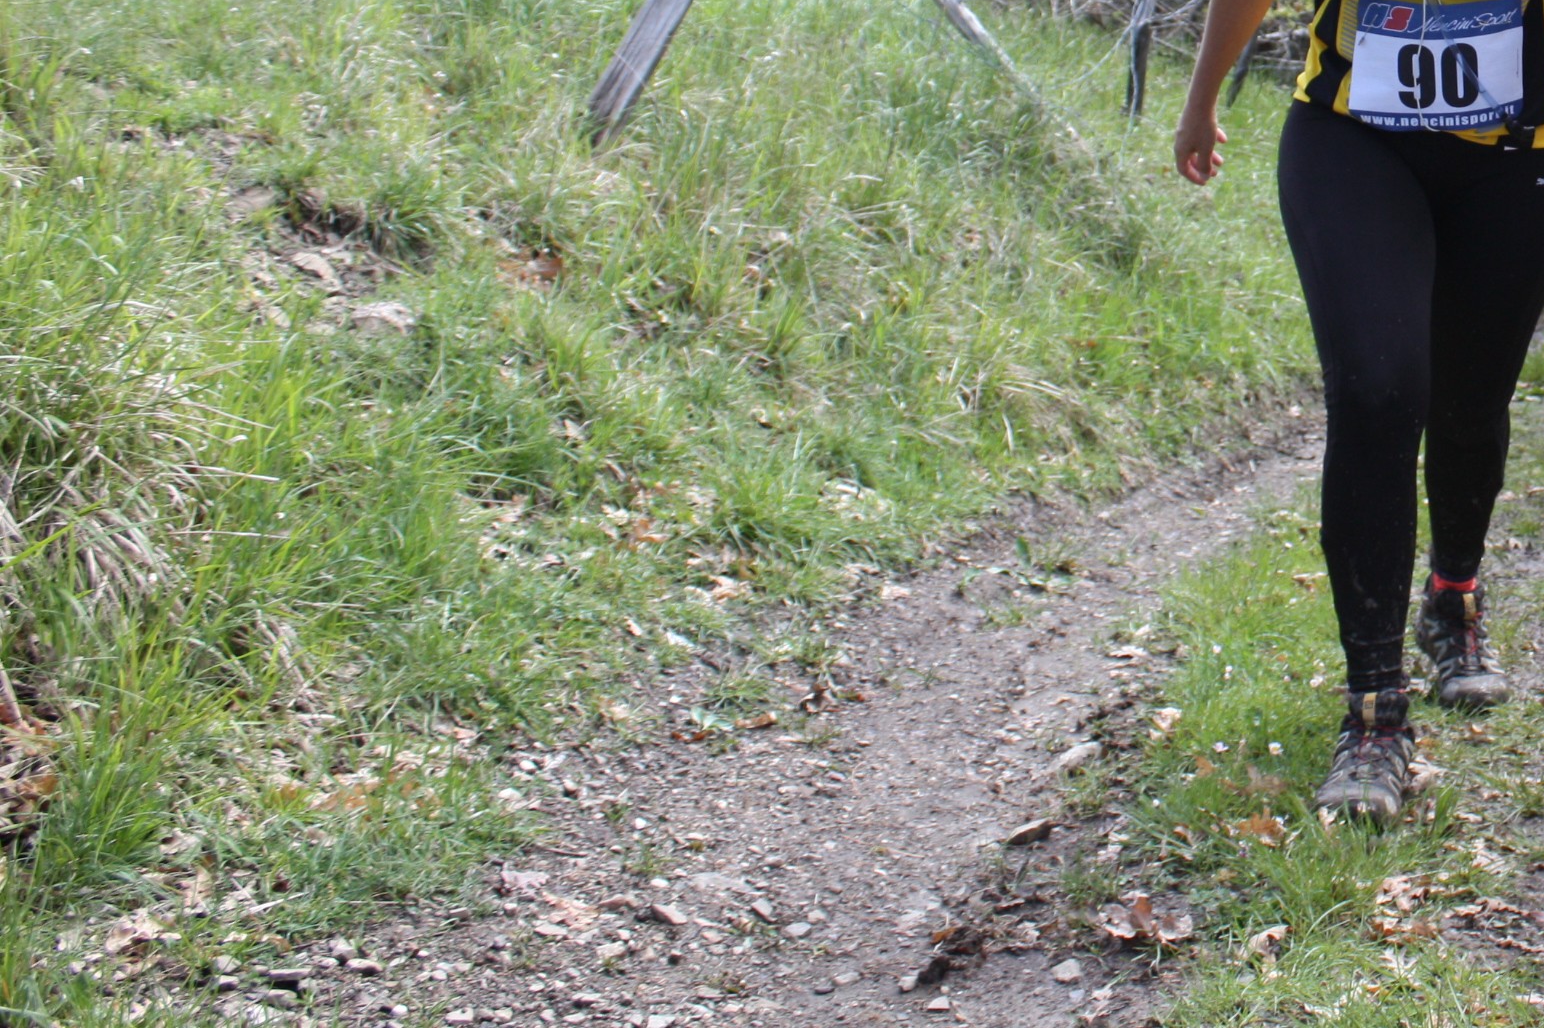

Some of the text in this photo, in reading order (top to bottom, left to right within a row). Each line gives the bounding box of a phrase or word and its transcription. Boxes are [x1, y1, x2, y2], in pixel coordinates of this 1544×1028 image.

[1407, 15, 1471, 33] Nencini
[1398, 43, 1479, 109] 90
[1360, 105, 1514, 126] www.nencinisporit
